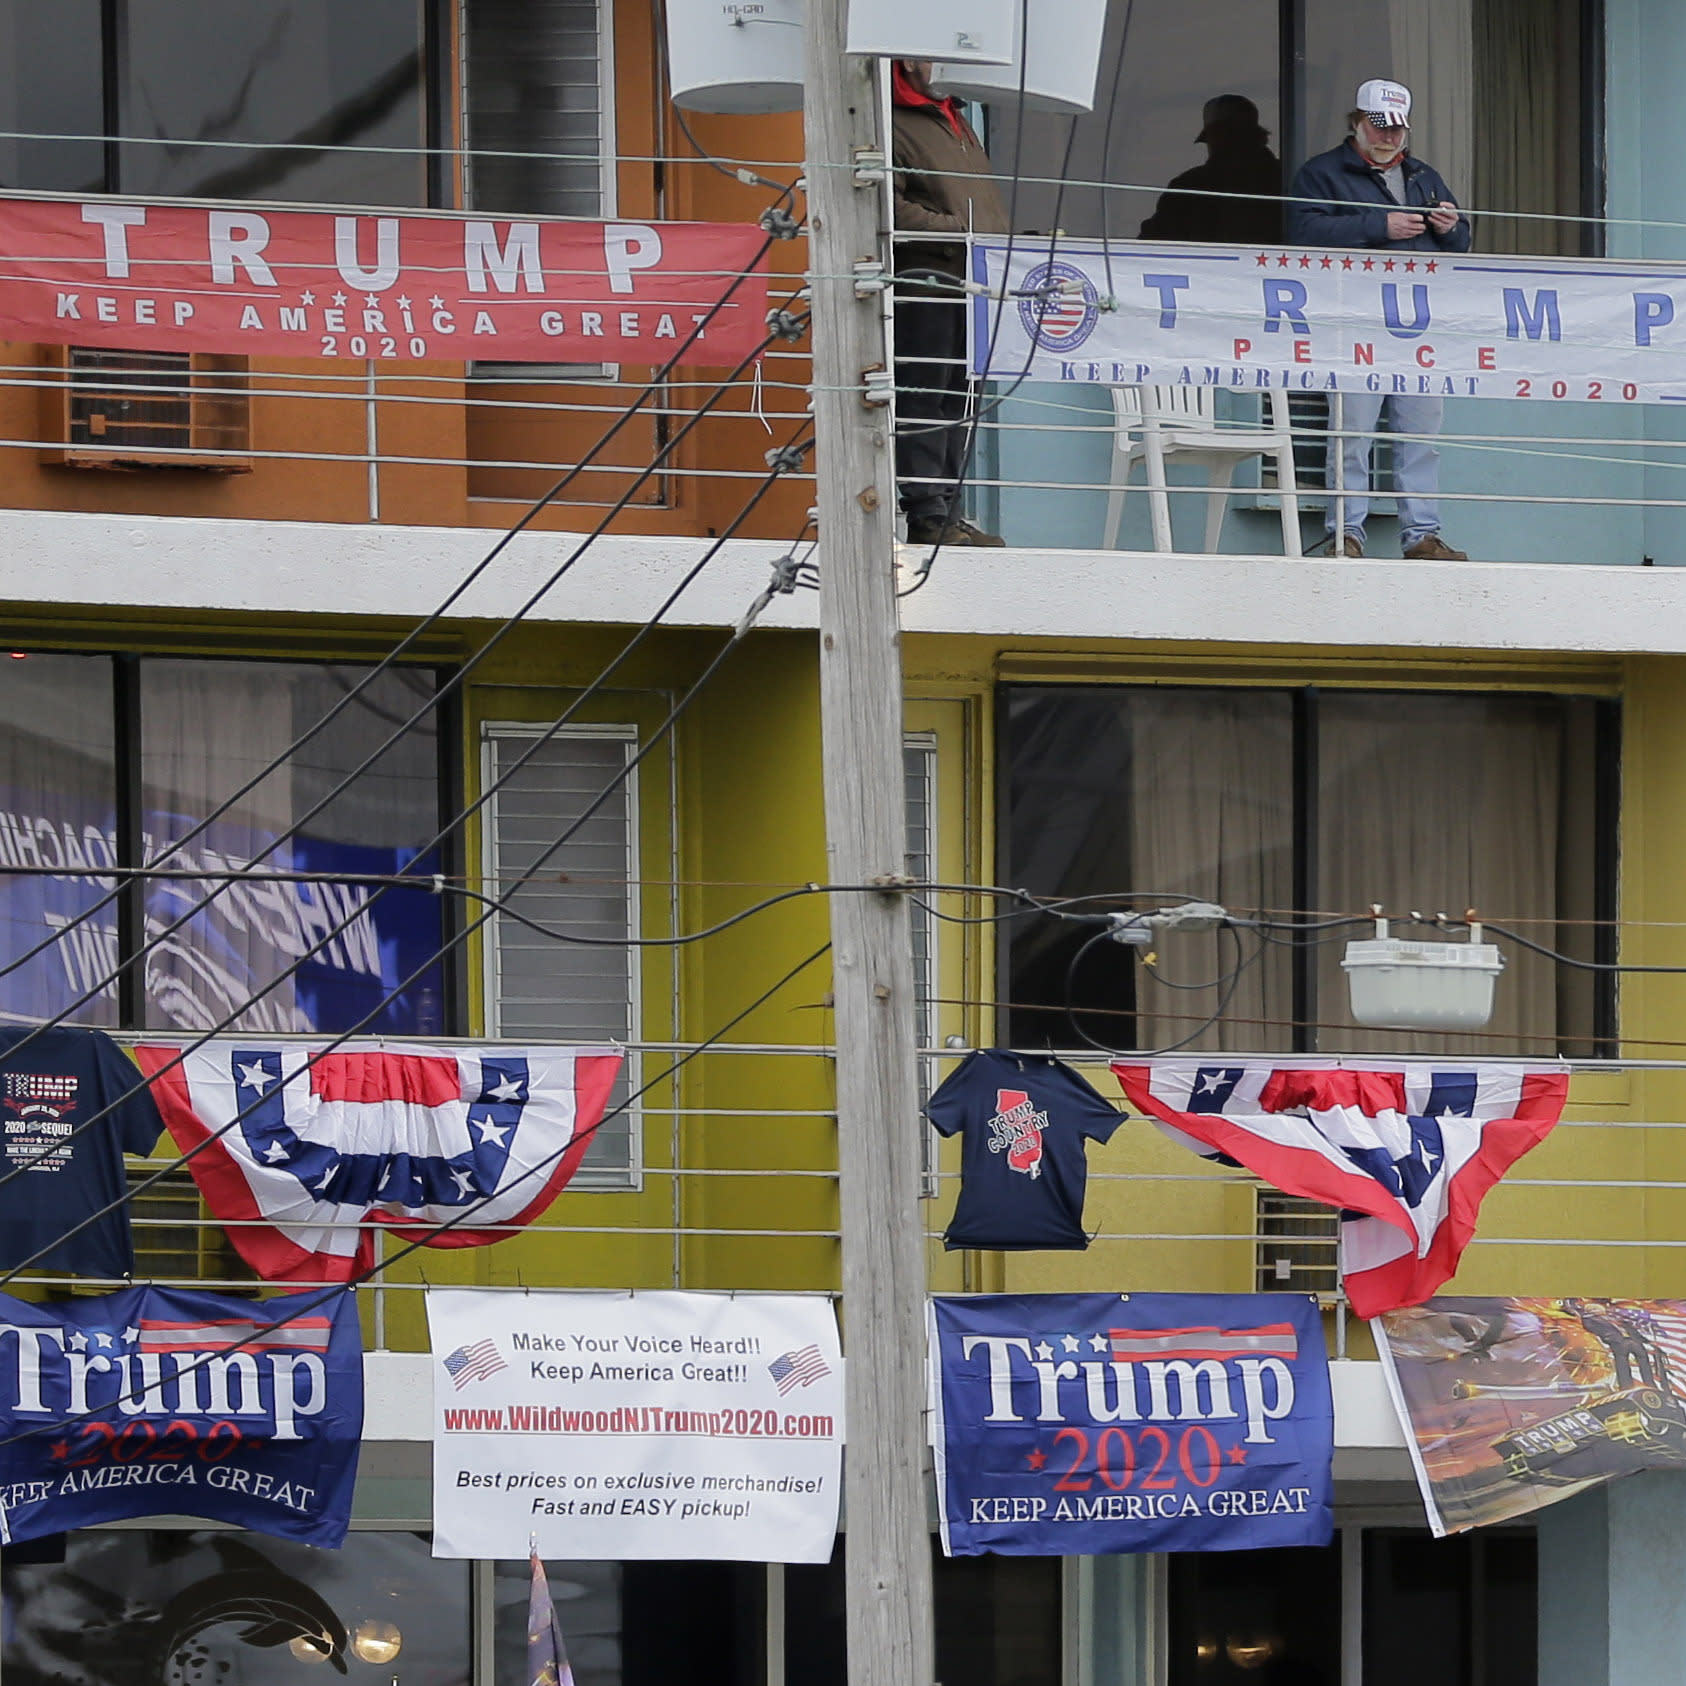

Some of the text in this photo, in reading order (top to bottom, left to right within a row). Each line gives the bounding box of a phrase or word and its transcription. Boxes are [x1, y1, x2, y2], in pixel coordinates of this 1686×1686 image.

[81, 205, 663, 294] TRUMP
[56, 292, 712, 340] KEEP AMERICA GREAT
[1143, 273, 1675, 348] TRUMP
[320, 335, 428, 359] 2020
[1233, 338, 1497, 371] PENCE
[1060, 360, 1638, 401] KEEP AMERICA GREAT 2020
[4, 1073, 80, 1100] TRUMP
[5, 1121, 25, 1133] 2020
[987, 1110, 1049, 1154] COUNTRY
[988, 1100, 1034, 1135] TRUMP
[512, 1331, 762, 1356] Make Your Voice Heard!!
[0, 1320, 328, 1440] Trump
[530, 1360, 749, 1385] Keep America Great!!
[963, 1334, 1296, 1446] Trump
[444, 1406, 834, 1440] www.WildwoodNJTrump2020.com
[1513, 1411, 1594, 1450] TRUMP
[72, 1419, 243, 1467] 2020
[1053, 1424, 1220, 1493] 2020
[57, 1462, 316, 1514] AMERICA GREAT
[457, 1471, 823, 1496] Best prices on exclusive merchandise!
[531, 1498, 752, 1523] Fast and EASY pickup!
[970, 1487, 1310, 1525] KEEP AMERICA GREAT
